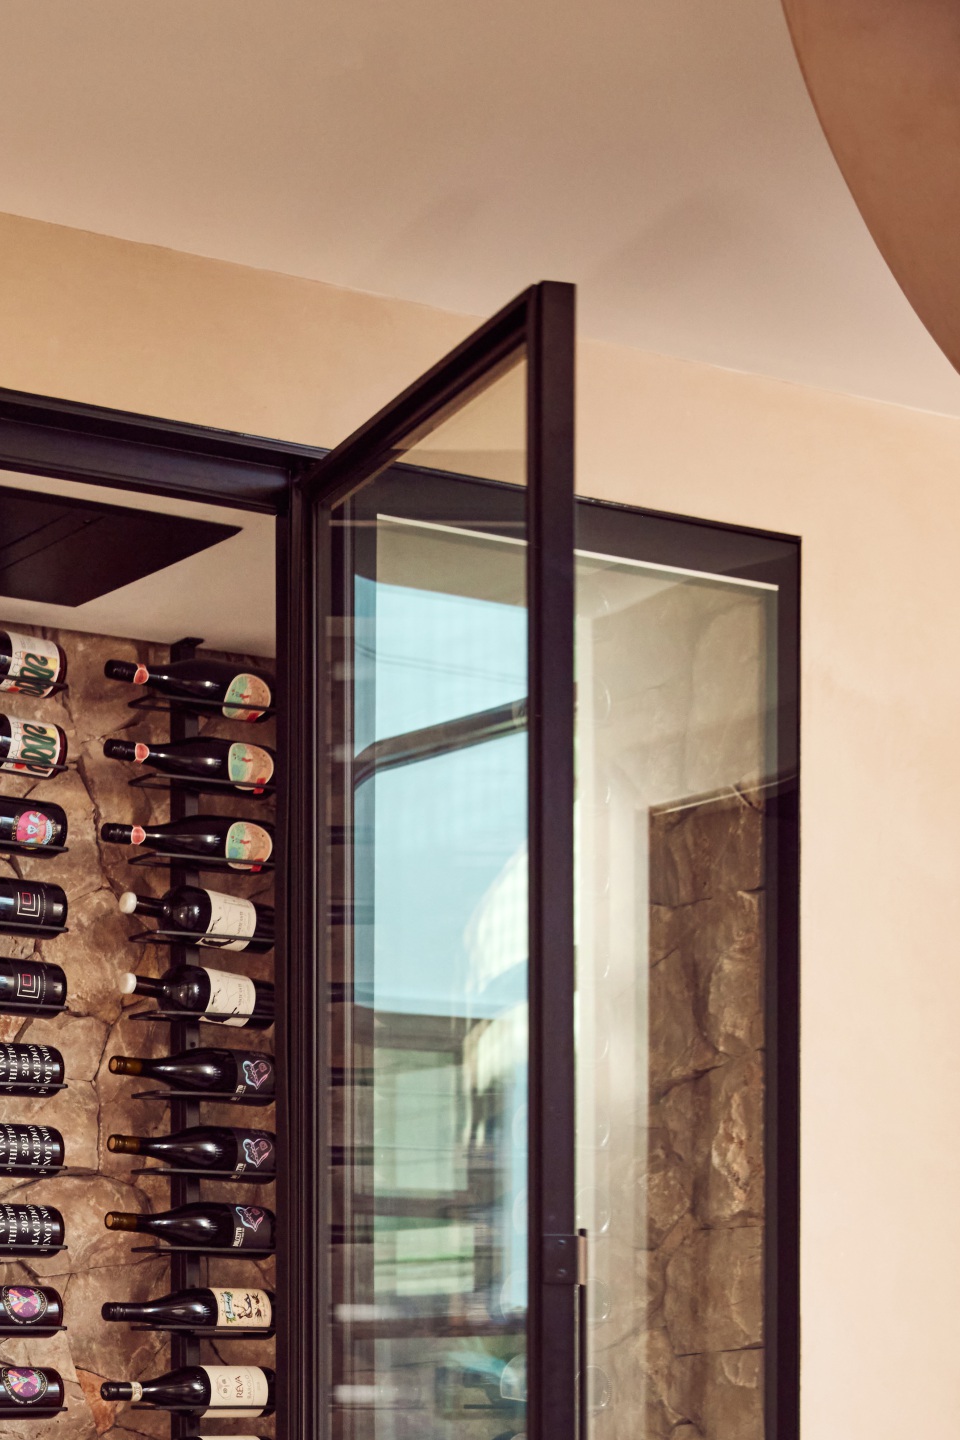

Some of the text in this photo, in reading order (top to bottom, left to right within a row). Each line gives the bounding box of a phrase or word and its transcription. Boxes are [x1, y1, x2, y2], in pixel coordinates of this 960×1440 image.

[20, 1054, 29, 1076] 2021
[20, 1134, 29, 1156] 2021
[39, 1144, 52, 1174] PNOT
[18, 1212, 29, 1234] 2021
[233, 1376, 244, 1398] RÉVA
[244, 1374, 252, 1399] BAROLO
